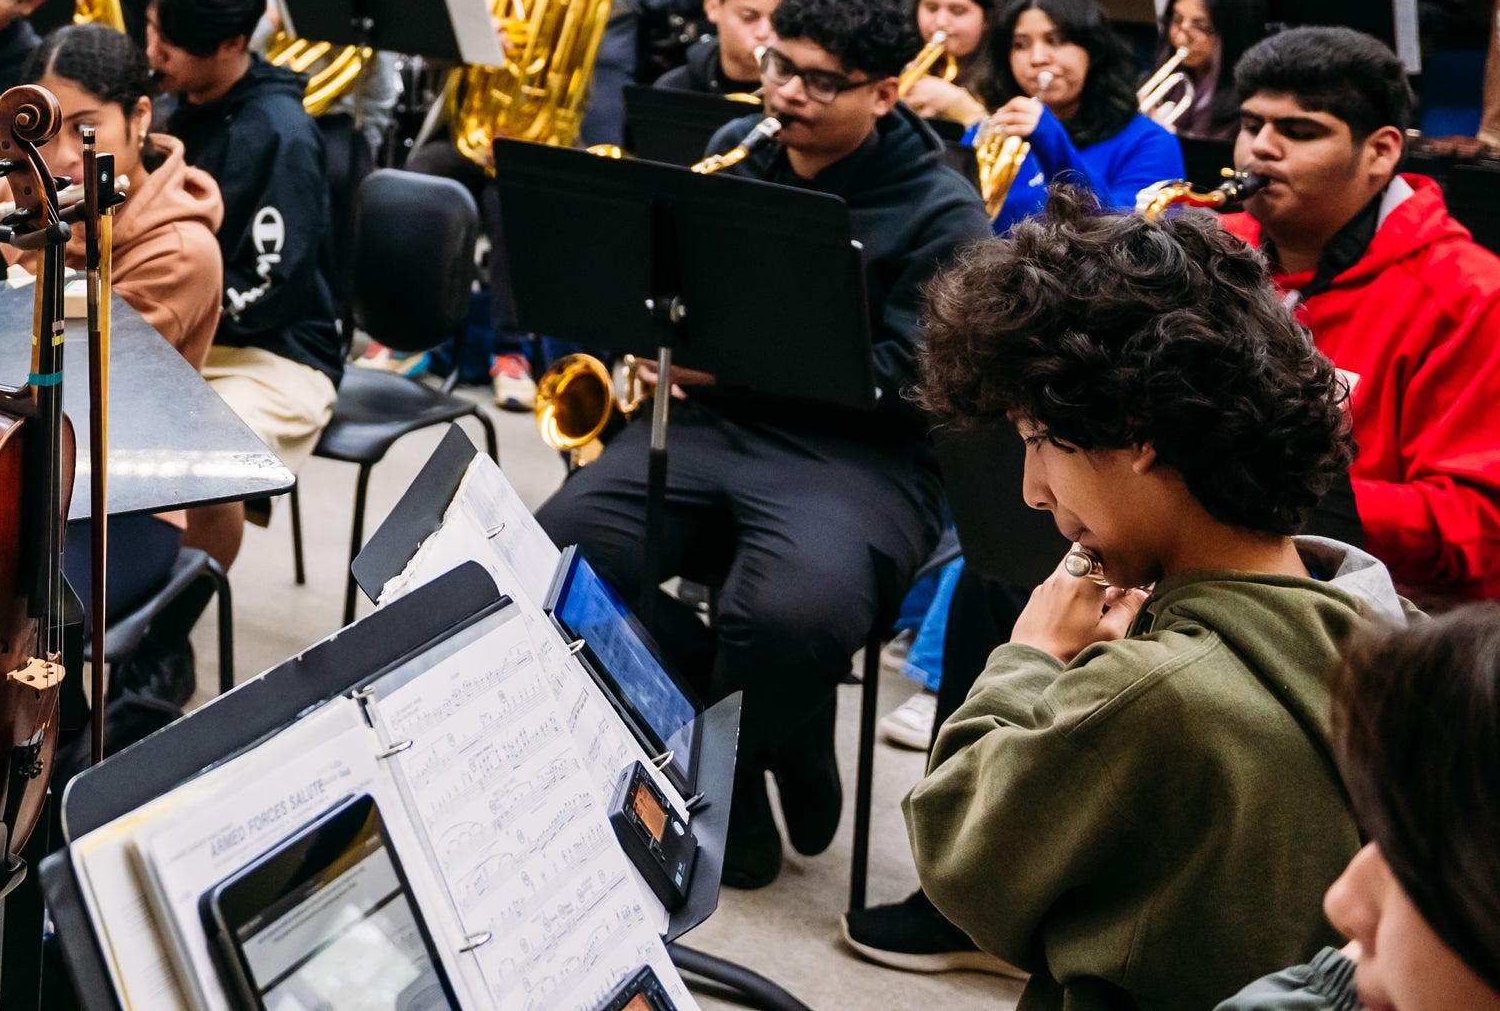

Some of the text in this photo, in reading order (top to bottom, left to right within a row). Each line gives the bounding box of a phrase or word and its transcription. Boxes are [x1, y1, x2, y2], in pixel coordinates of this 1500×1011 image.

[211, 826, 245, 856] ARMED
[249, 801, 287, 831] FORCES
[289, 779, 325, 810] SALUTE
